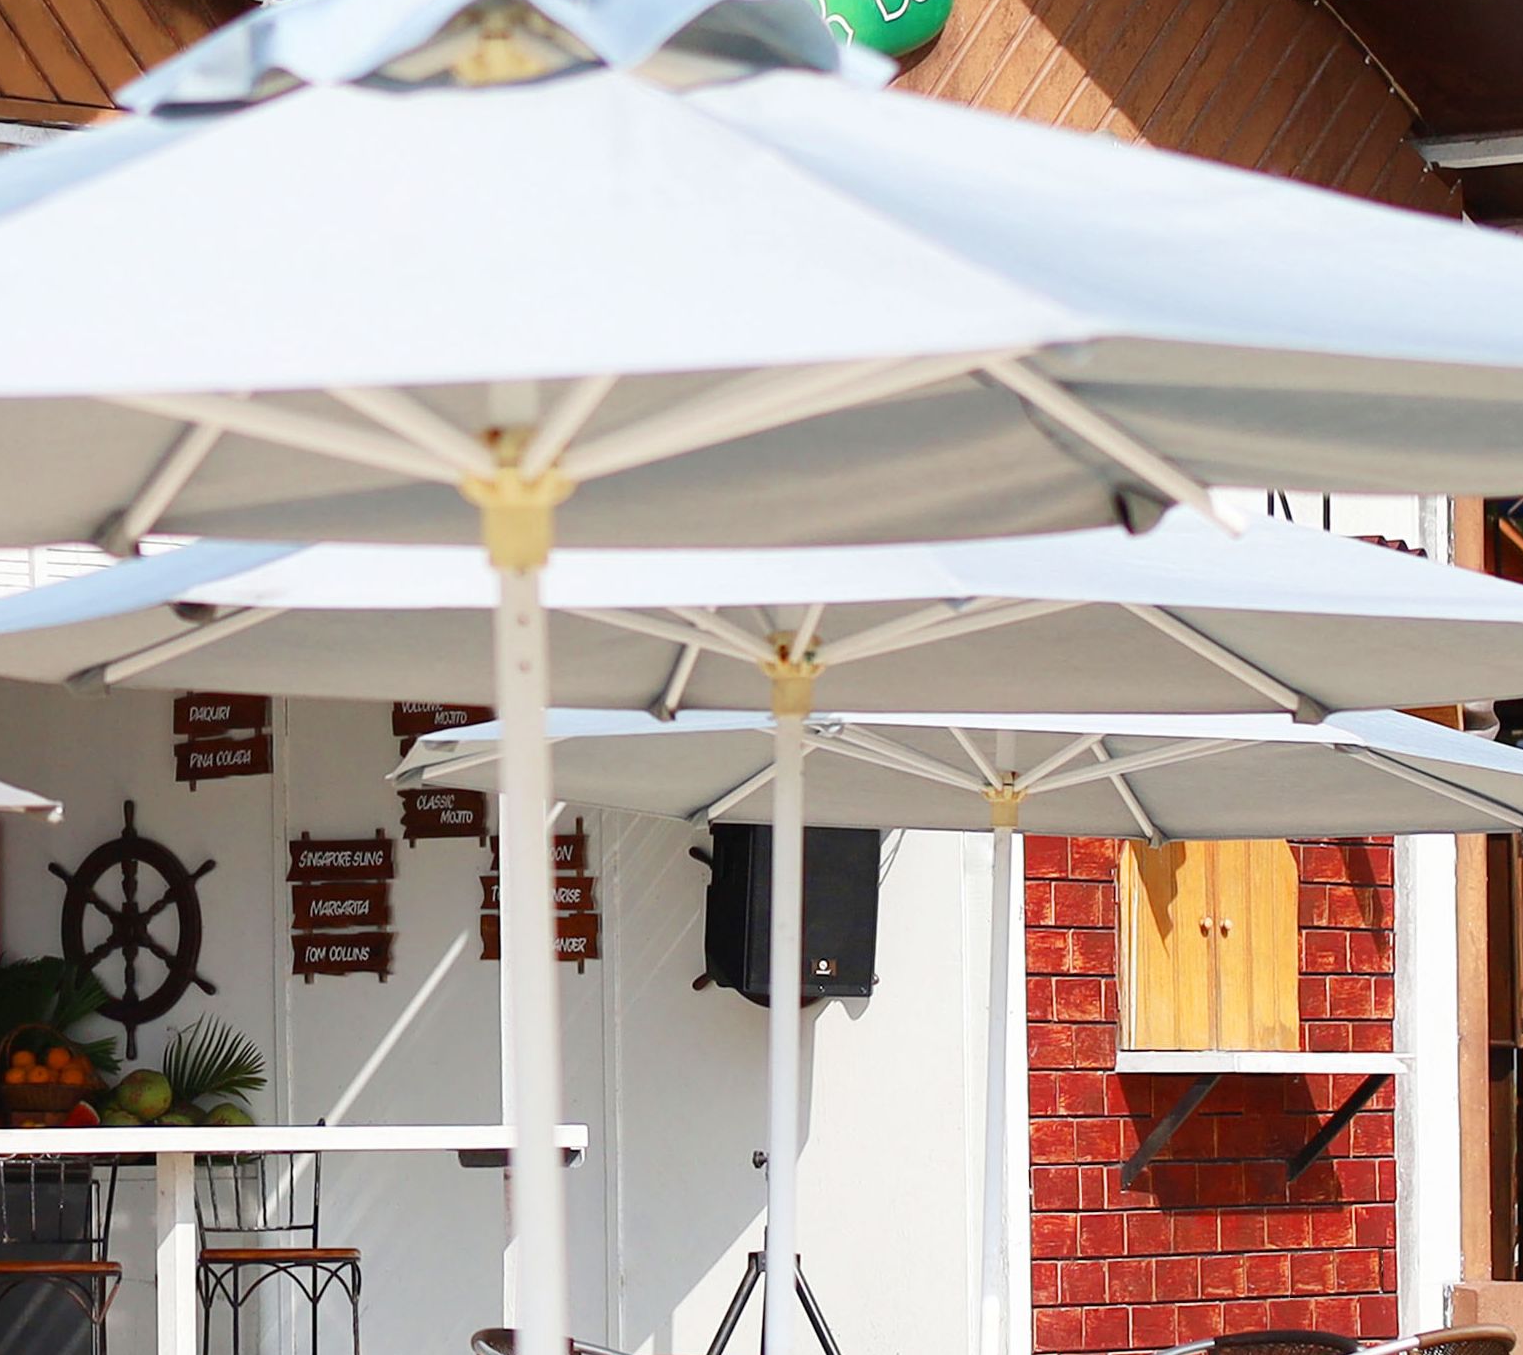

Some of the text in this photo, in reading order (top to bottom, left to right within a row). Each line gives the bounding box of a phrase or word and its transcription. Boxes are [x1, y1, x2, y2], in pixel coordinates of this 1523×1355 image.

[434, 710, 468, 725] MOJITO
[216, 749, 252, 766] COLADA
[416, 794, 455, 810] CLASSIC
[440, 809, 473, 824] MOJITO
[298, 850, 384, 868] SINGAPORE SLING
[310, 899, 370, 917] MARGARITA
[305, 946, 370, 963] TOM COLLINS
